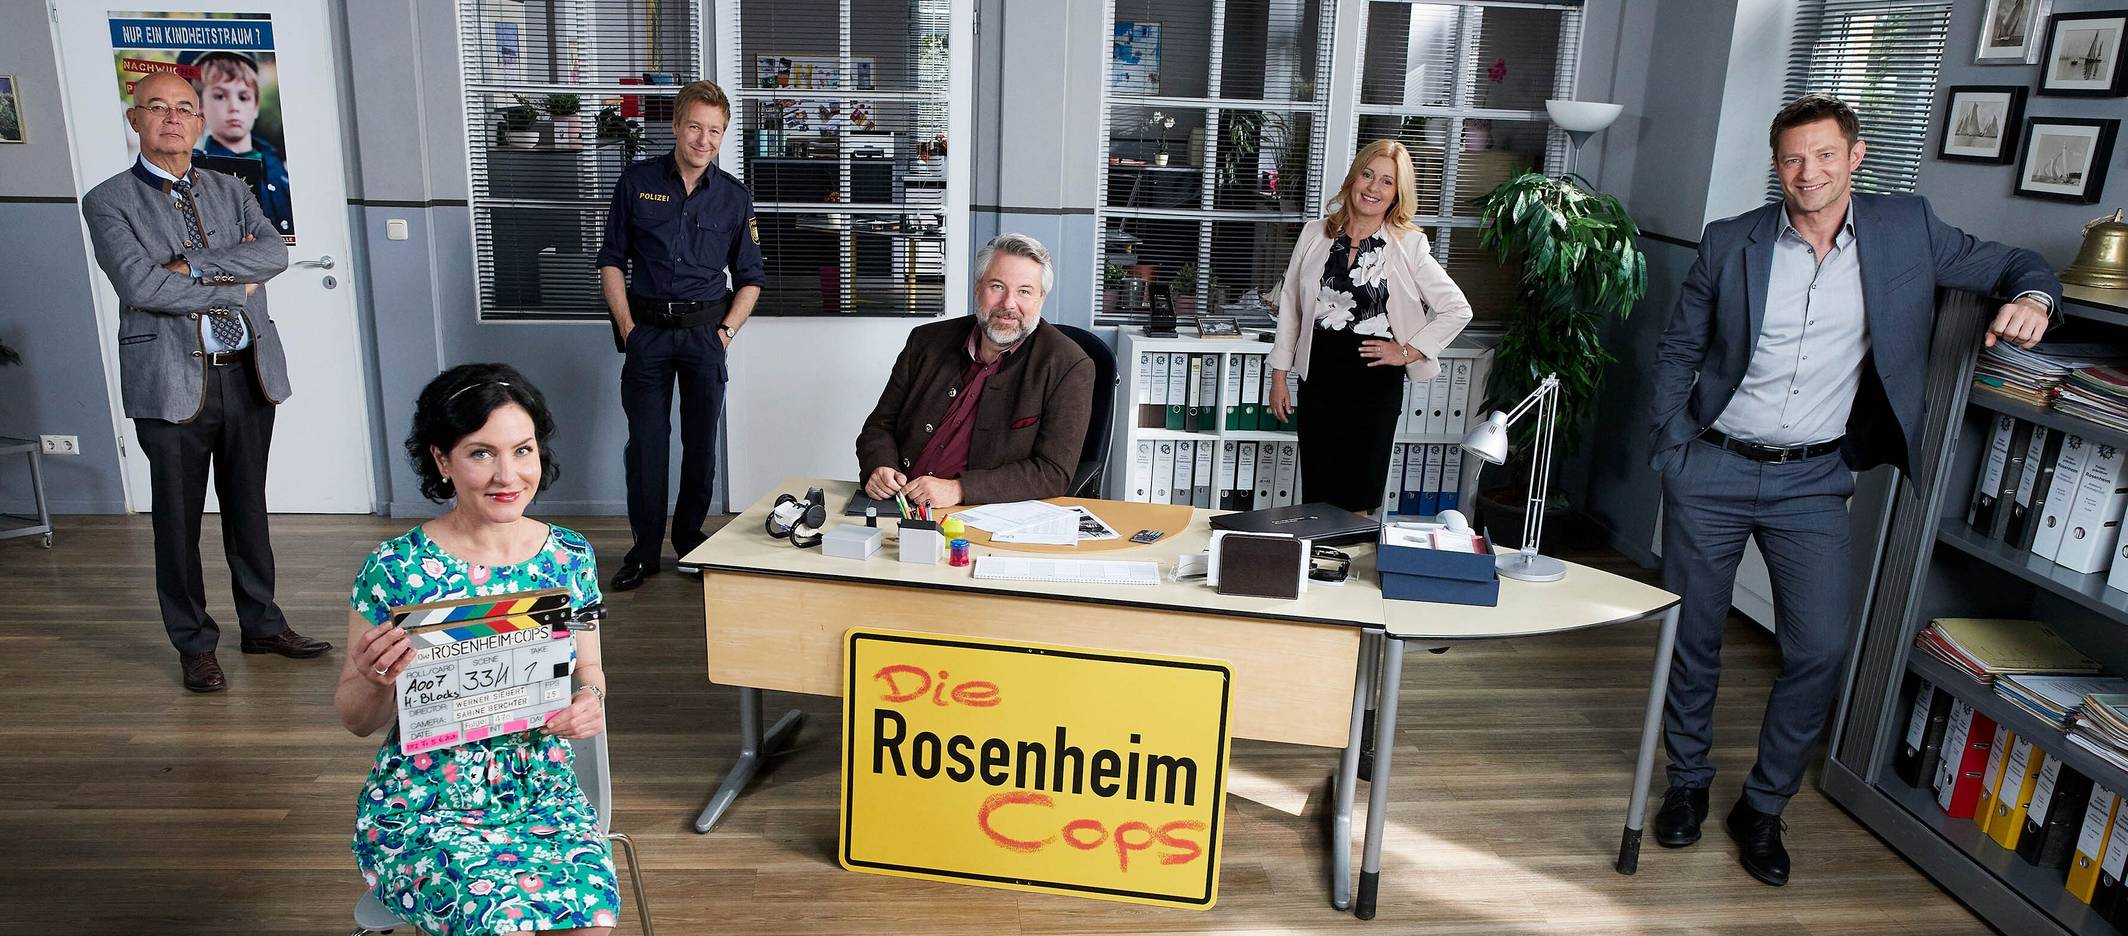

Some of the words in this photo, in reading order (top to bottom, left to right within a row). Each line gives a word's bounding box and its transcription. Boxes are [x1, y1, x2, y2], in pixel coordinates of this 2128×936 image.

[122, 26, 143, 44] NUR
[146, 26, 162, 44] EIN
[164, 26, 253, 45] KINDHEITSTRAUM
[639, 192, 670, 202] POLIZEI
[530, 646, 549, 654] TAKE
[473, 655, 499, 667] SCENE
[873, 664, 1002, 708] Die
[456, 694, 489, 708] WERNER
[456, 706, 486, 719] SABINE
[529, 715, 544, 723] DAY
[872, 708, 1198, 806] Rosenheim
[978, 791, 1206, 873] Cops
